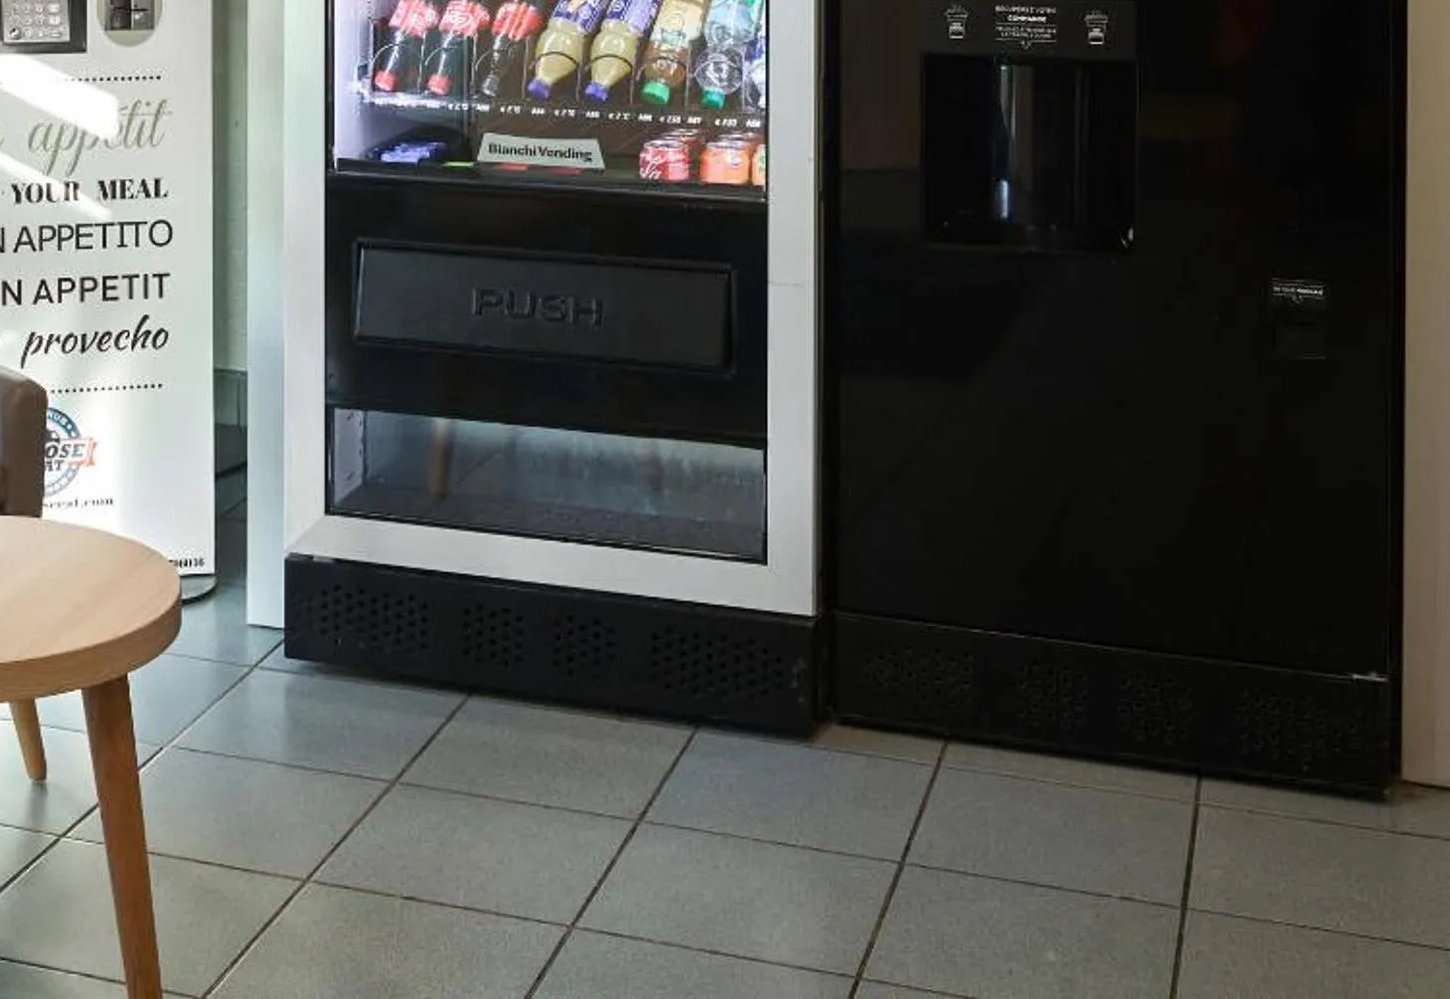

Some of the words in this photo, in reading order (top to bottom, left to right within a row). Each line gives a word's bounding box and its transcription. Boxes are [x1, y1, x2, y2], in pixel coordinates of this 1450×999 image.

[27, 98, 174, 178] apptit
[487, 142, 537, 157] Bianchi
[538, 145, 593, 163] Vending
[10, 180, 81, 205] YOUR
[98, 177, 169, 201] MEAL
[12, 218, 174, 253] APPETITO
[32, 273, 171, 305] APPETIT
[472, 286, 604, 330] PUSH
[20, 313, 170, 369] provecho
[45, 443, 86, 460] OSE
